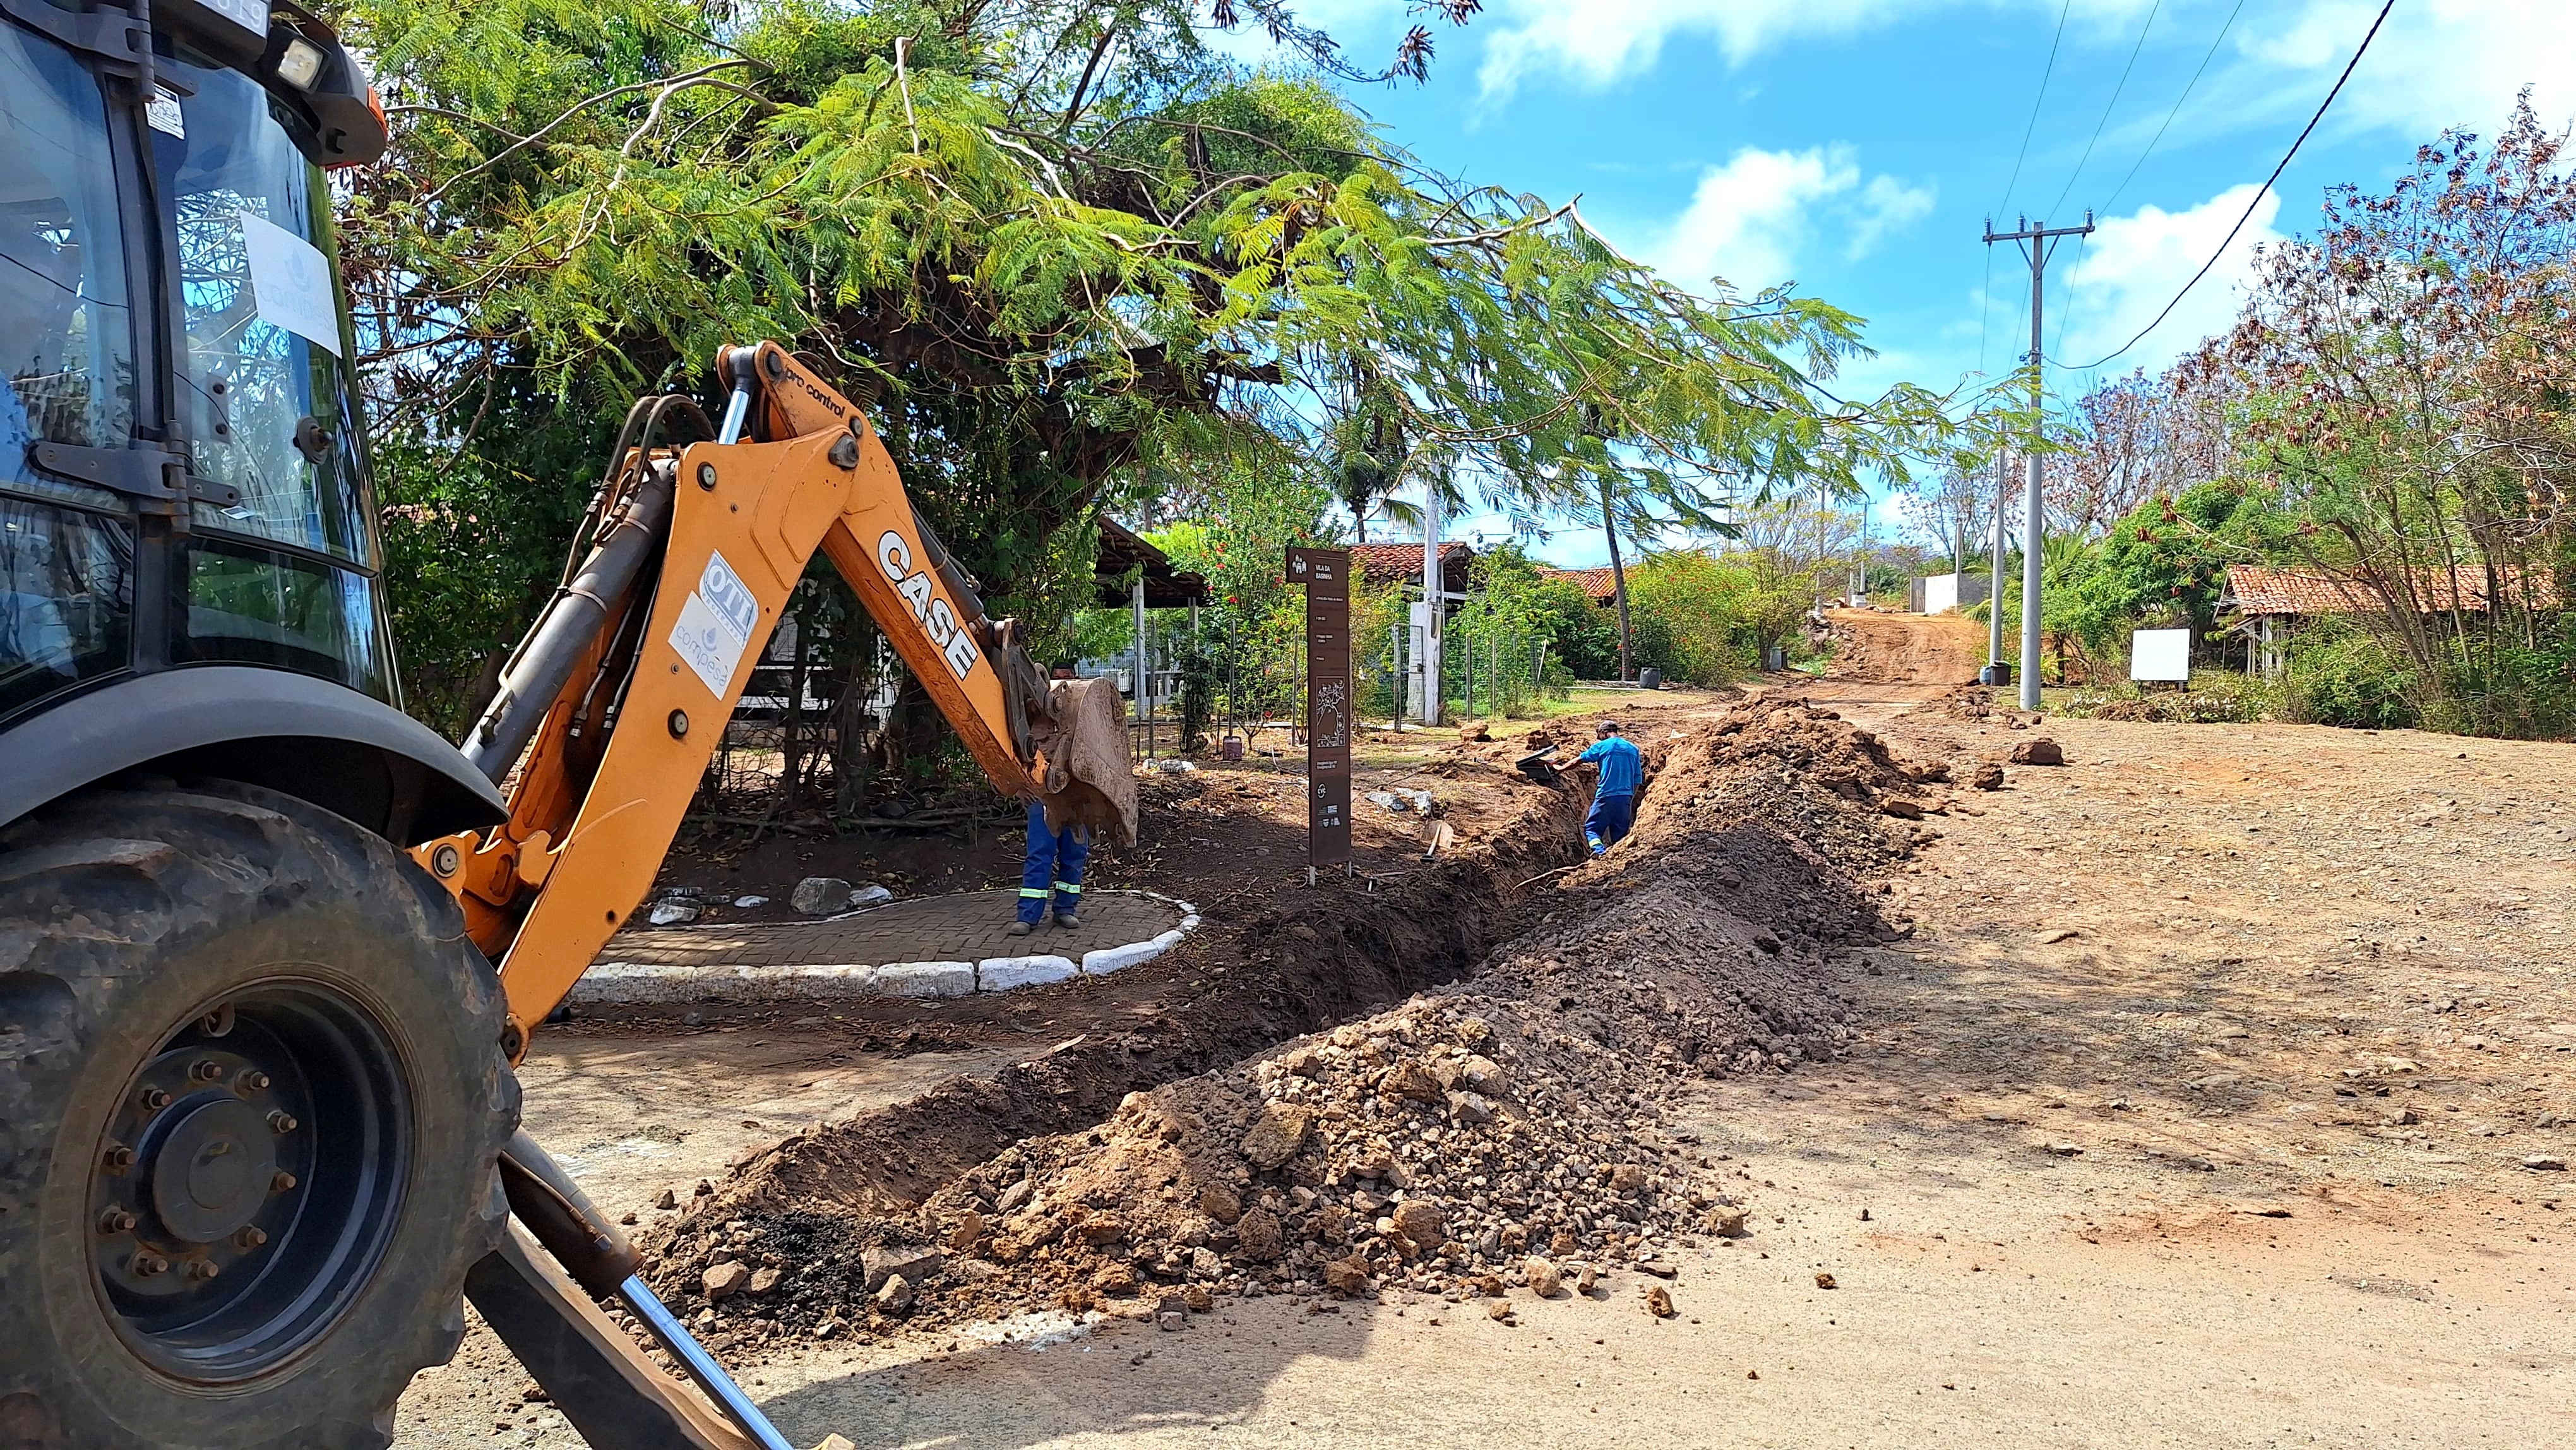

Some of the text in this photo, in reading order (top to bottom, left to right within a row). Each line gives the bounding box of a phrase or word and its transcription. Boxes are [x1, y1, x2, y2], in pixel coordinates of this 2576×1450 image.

[786, 368, 845, 419] pro control
[878, 529, 979, 682] CASE
[676, 626, 728, 687] compesa
